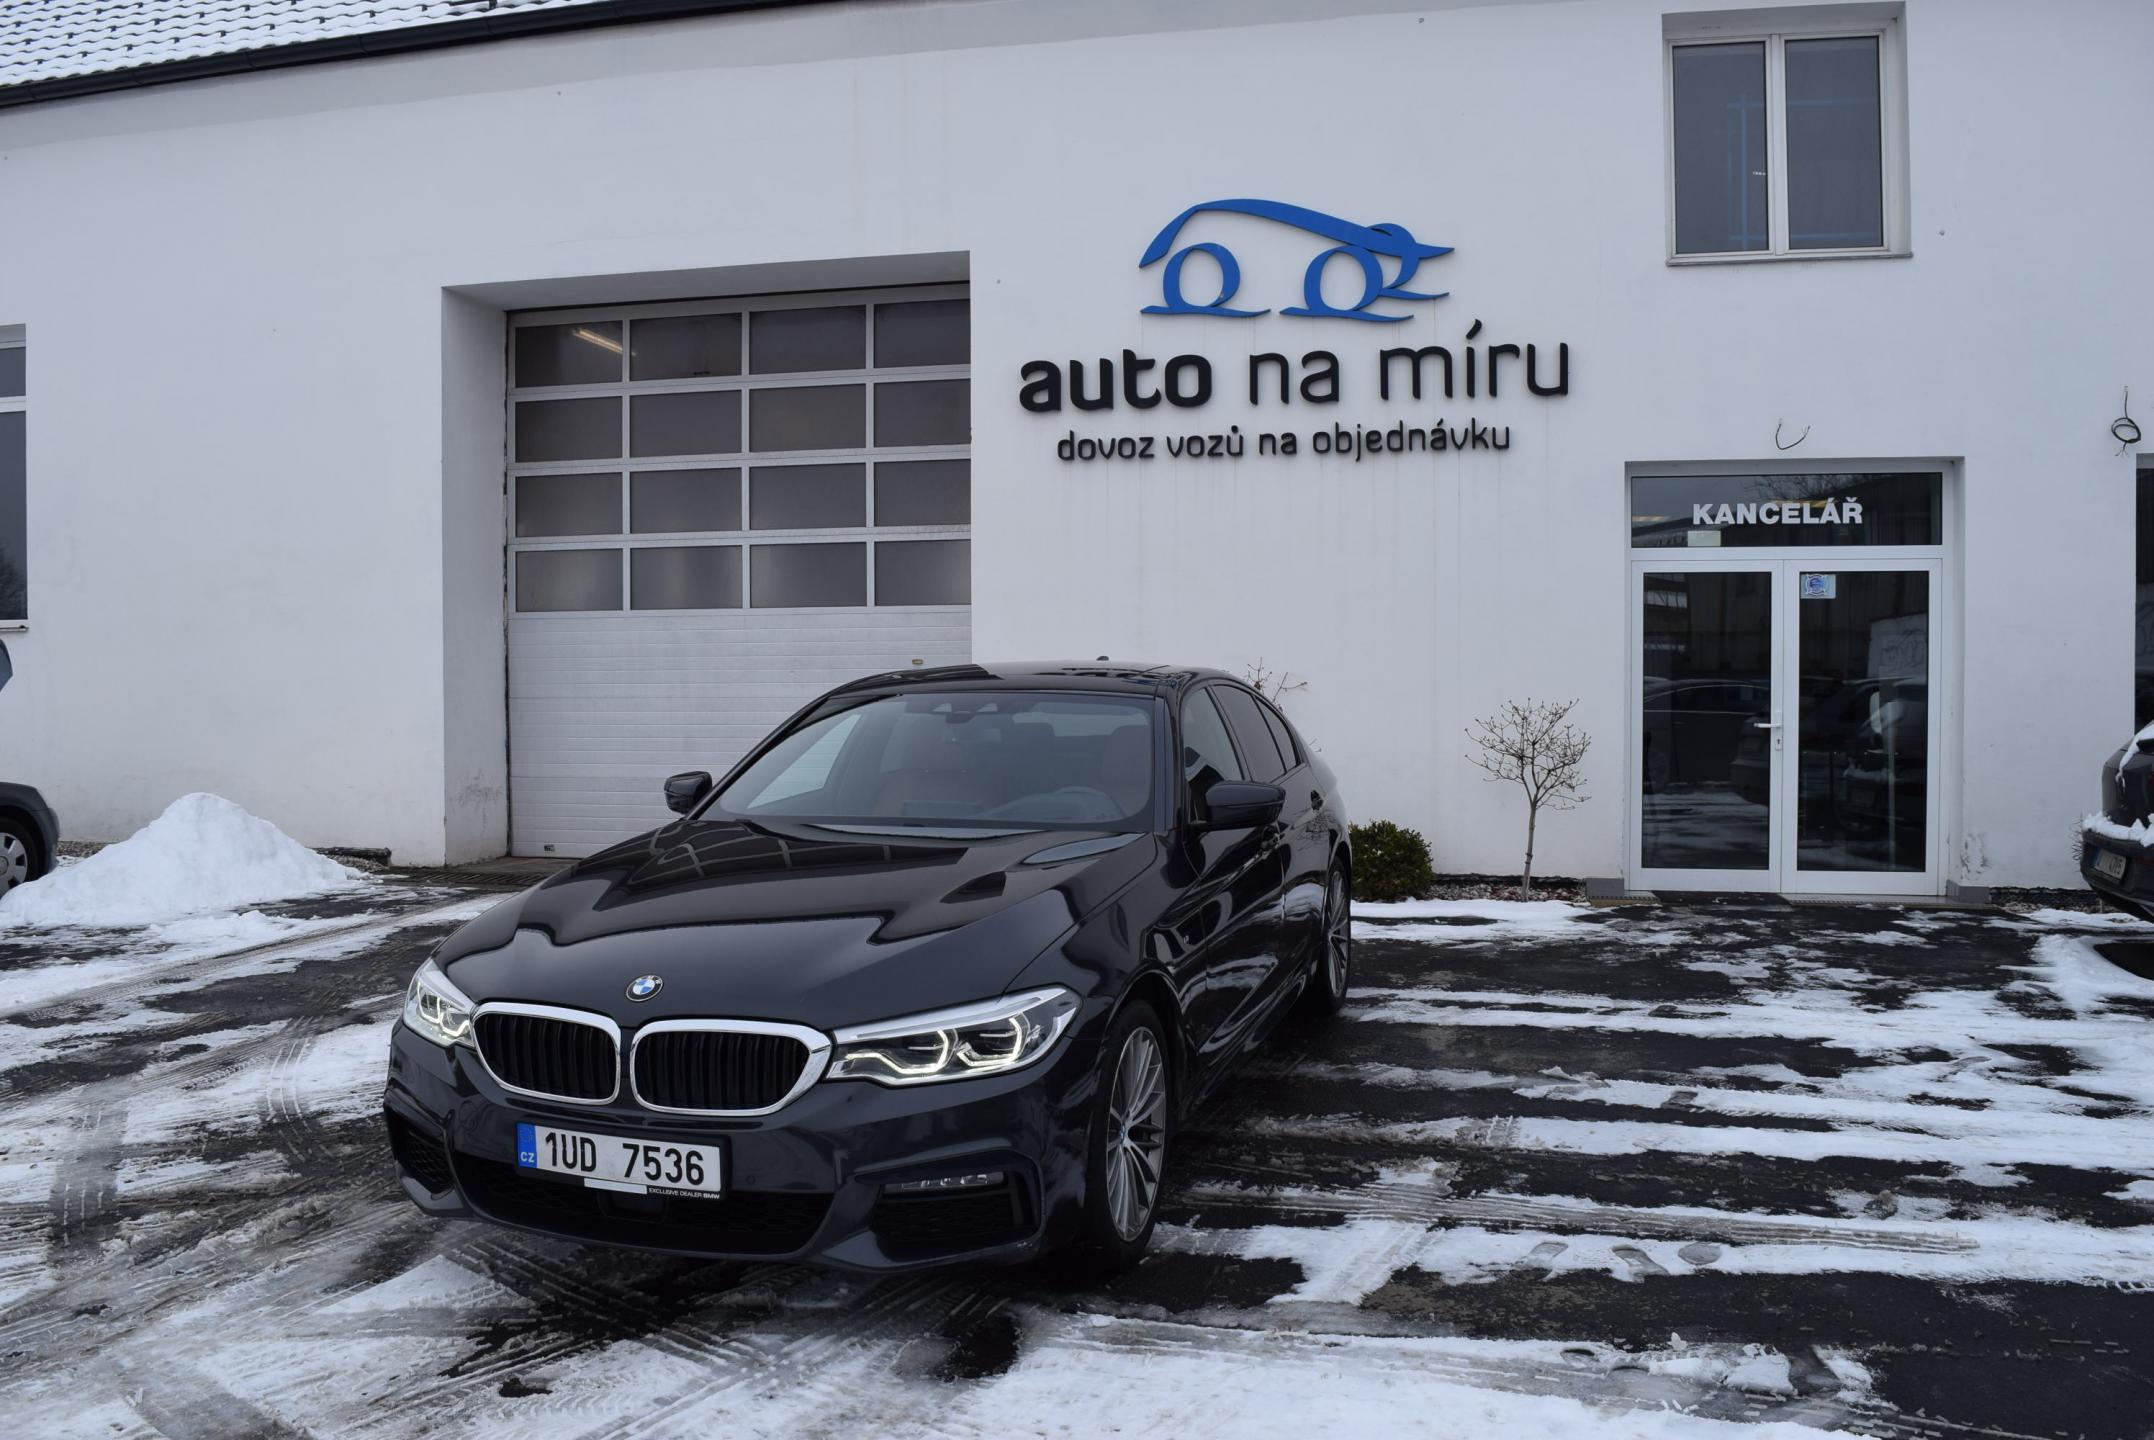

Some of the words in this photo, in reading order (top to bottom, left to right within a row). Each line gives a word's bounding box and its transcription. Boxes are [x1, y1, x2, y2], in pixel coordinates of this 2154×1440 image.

[1019, 349, 1213, 413] auto
[1249, 350, 1340, 406] na
[1379, 318, 1570, 401] míru
[1057, 430, 1155, 462] dovoz
[1166, 425, 1244, 459] vozů
[1258, 432, 1298, 456] na
[1312, 417, 1511, 463] objednávku
[1692, 497, 1864, 525] KANCELÁŘ
[520, 1151, 535, 1163] CZ
[545, 1131, 597, 1173] 1UD
[622, 1142, 705, 1186] 7536
[649, 1187, 679, 1195] EXCLUSIVE
